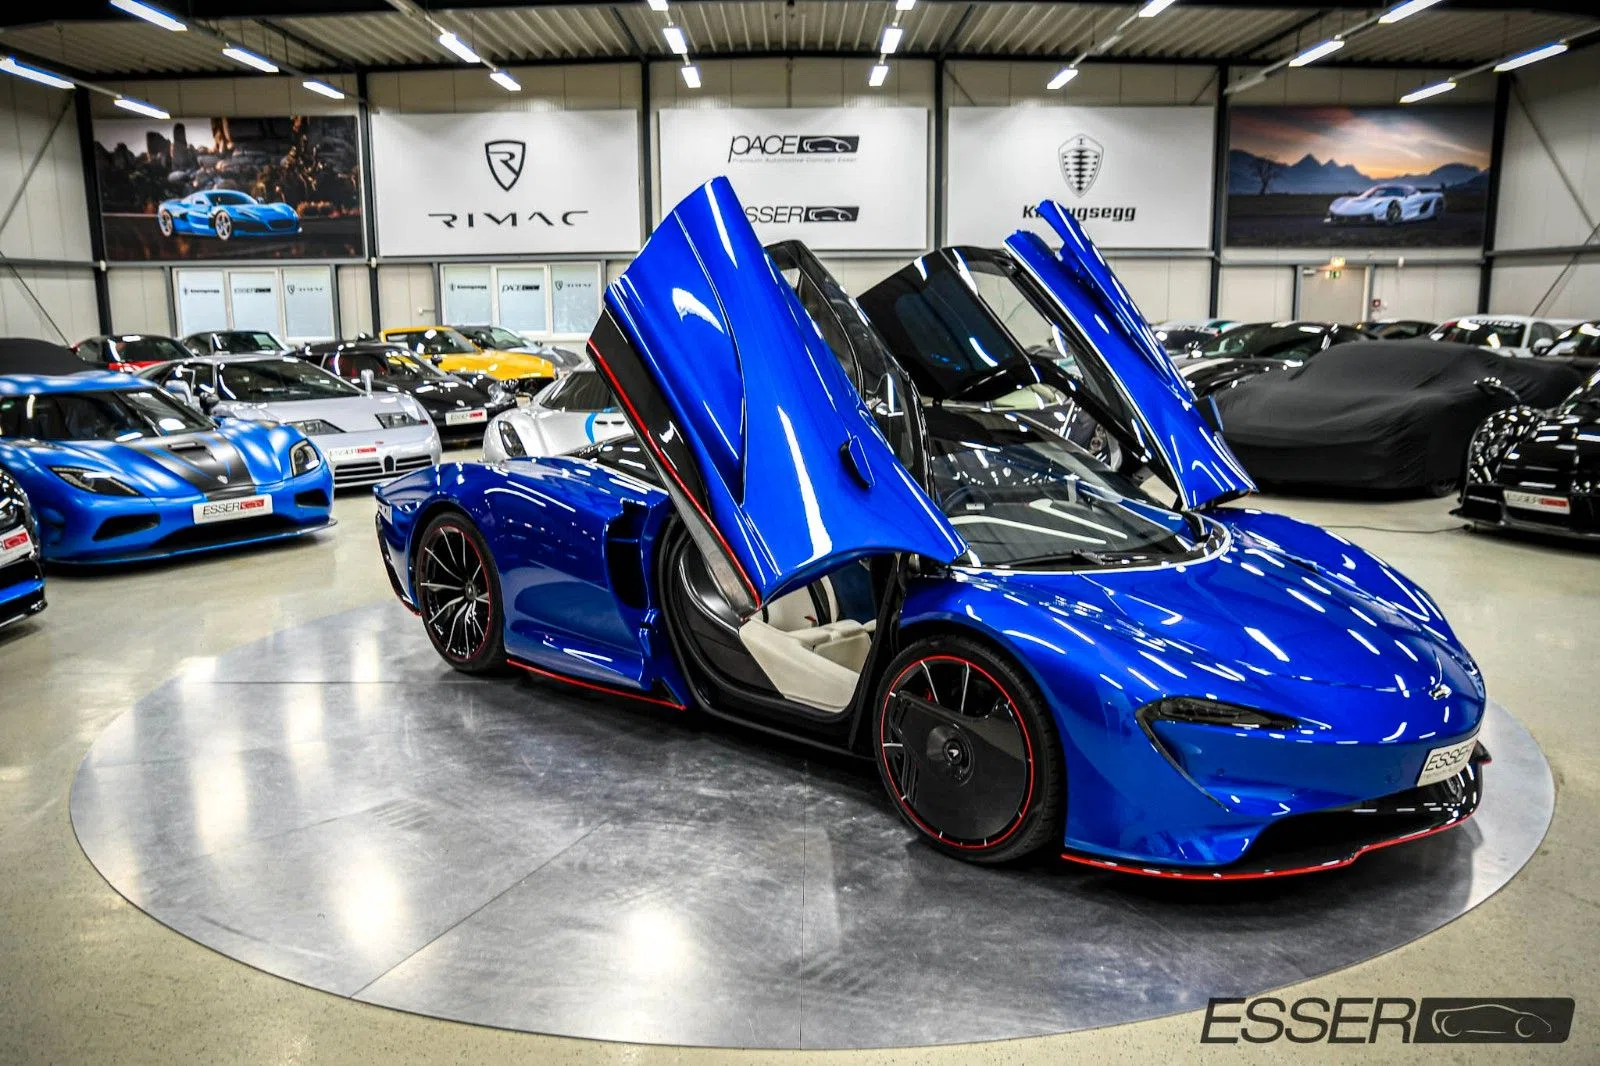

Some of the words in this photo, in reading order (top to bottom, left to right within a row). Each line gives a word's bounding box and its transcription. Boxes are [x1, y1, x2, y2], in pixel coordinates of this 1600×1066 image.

[428, 210, 589, 228] RIMAC
[743, 206, 804, 224] SSER
[203, 501, 241, 516] ESSER
